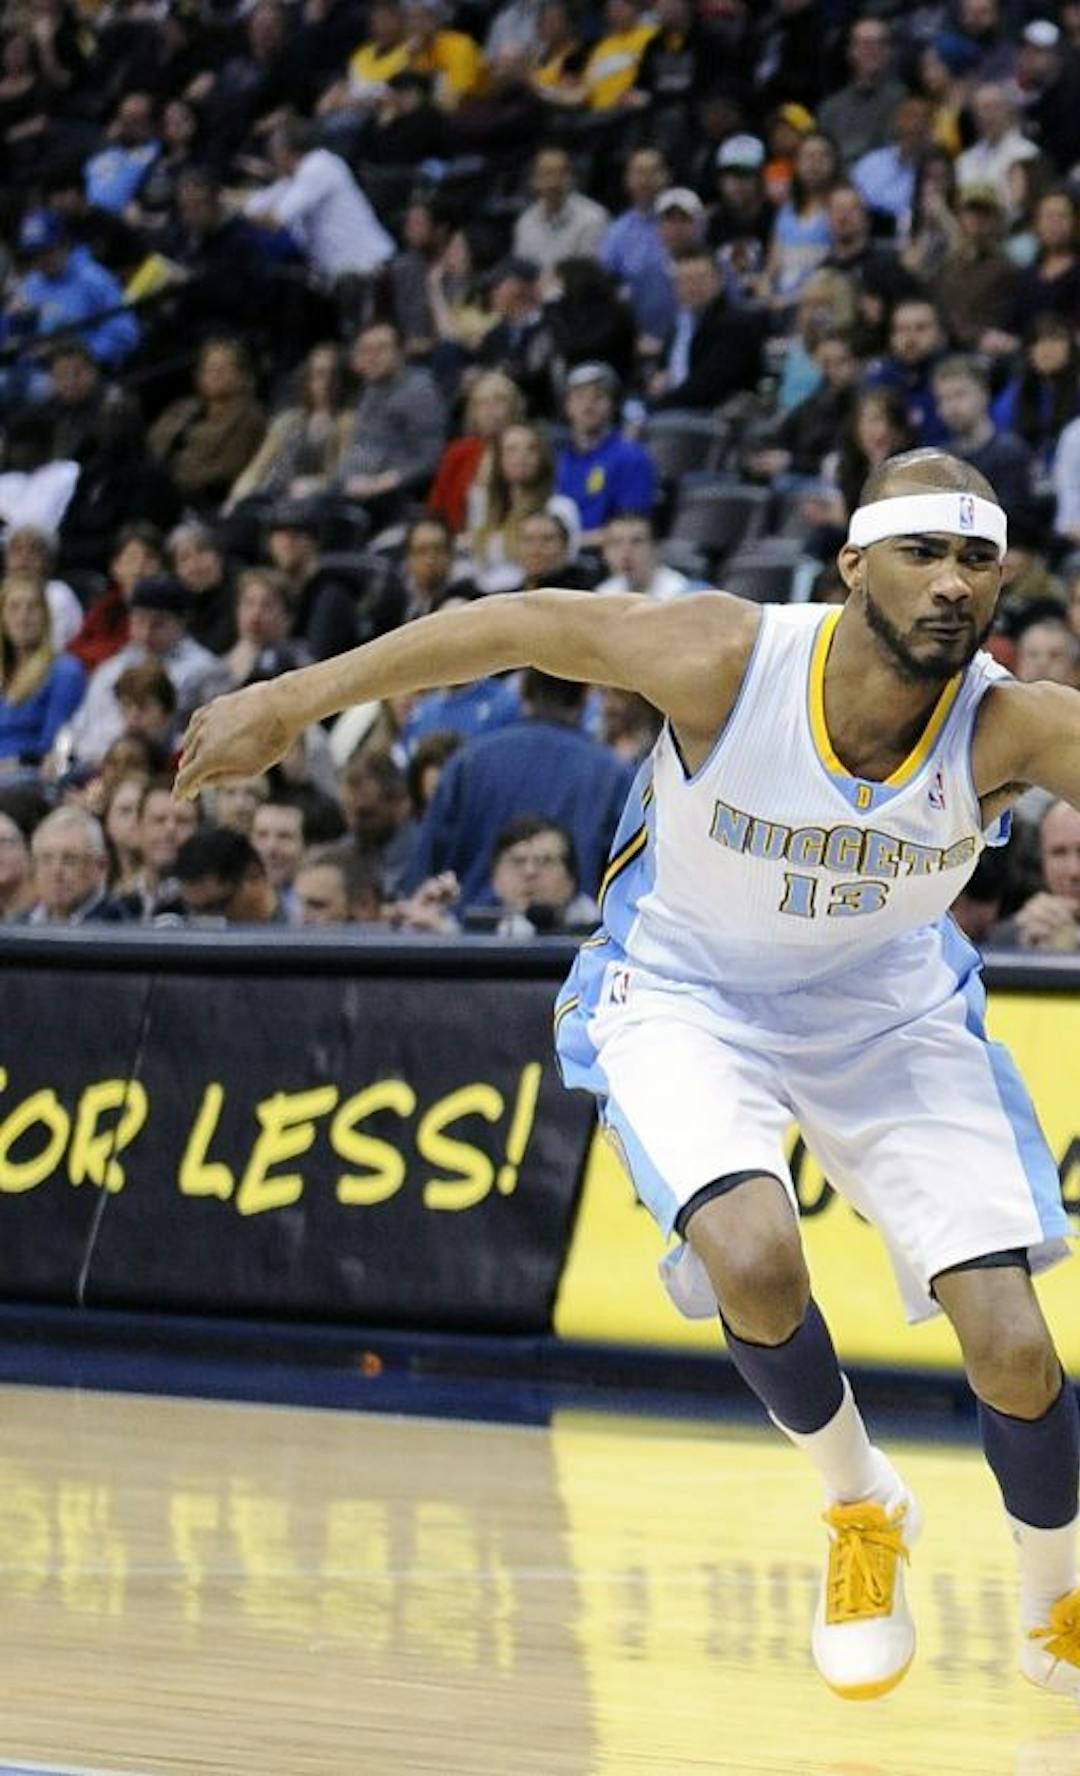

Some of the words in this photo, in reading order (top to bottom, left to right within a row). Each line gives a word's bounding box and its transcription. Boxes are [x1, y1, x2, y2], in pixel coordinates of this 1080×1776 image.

[709, 799, 977, 877] NUGGETS
[778, 872, 889, 918] 13
[0, 1066, 148, 1194] OR
[178, 1062, 542, 1217] LESS!
